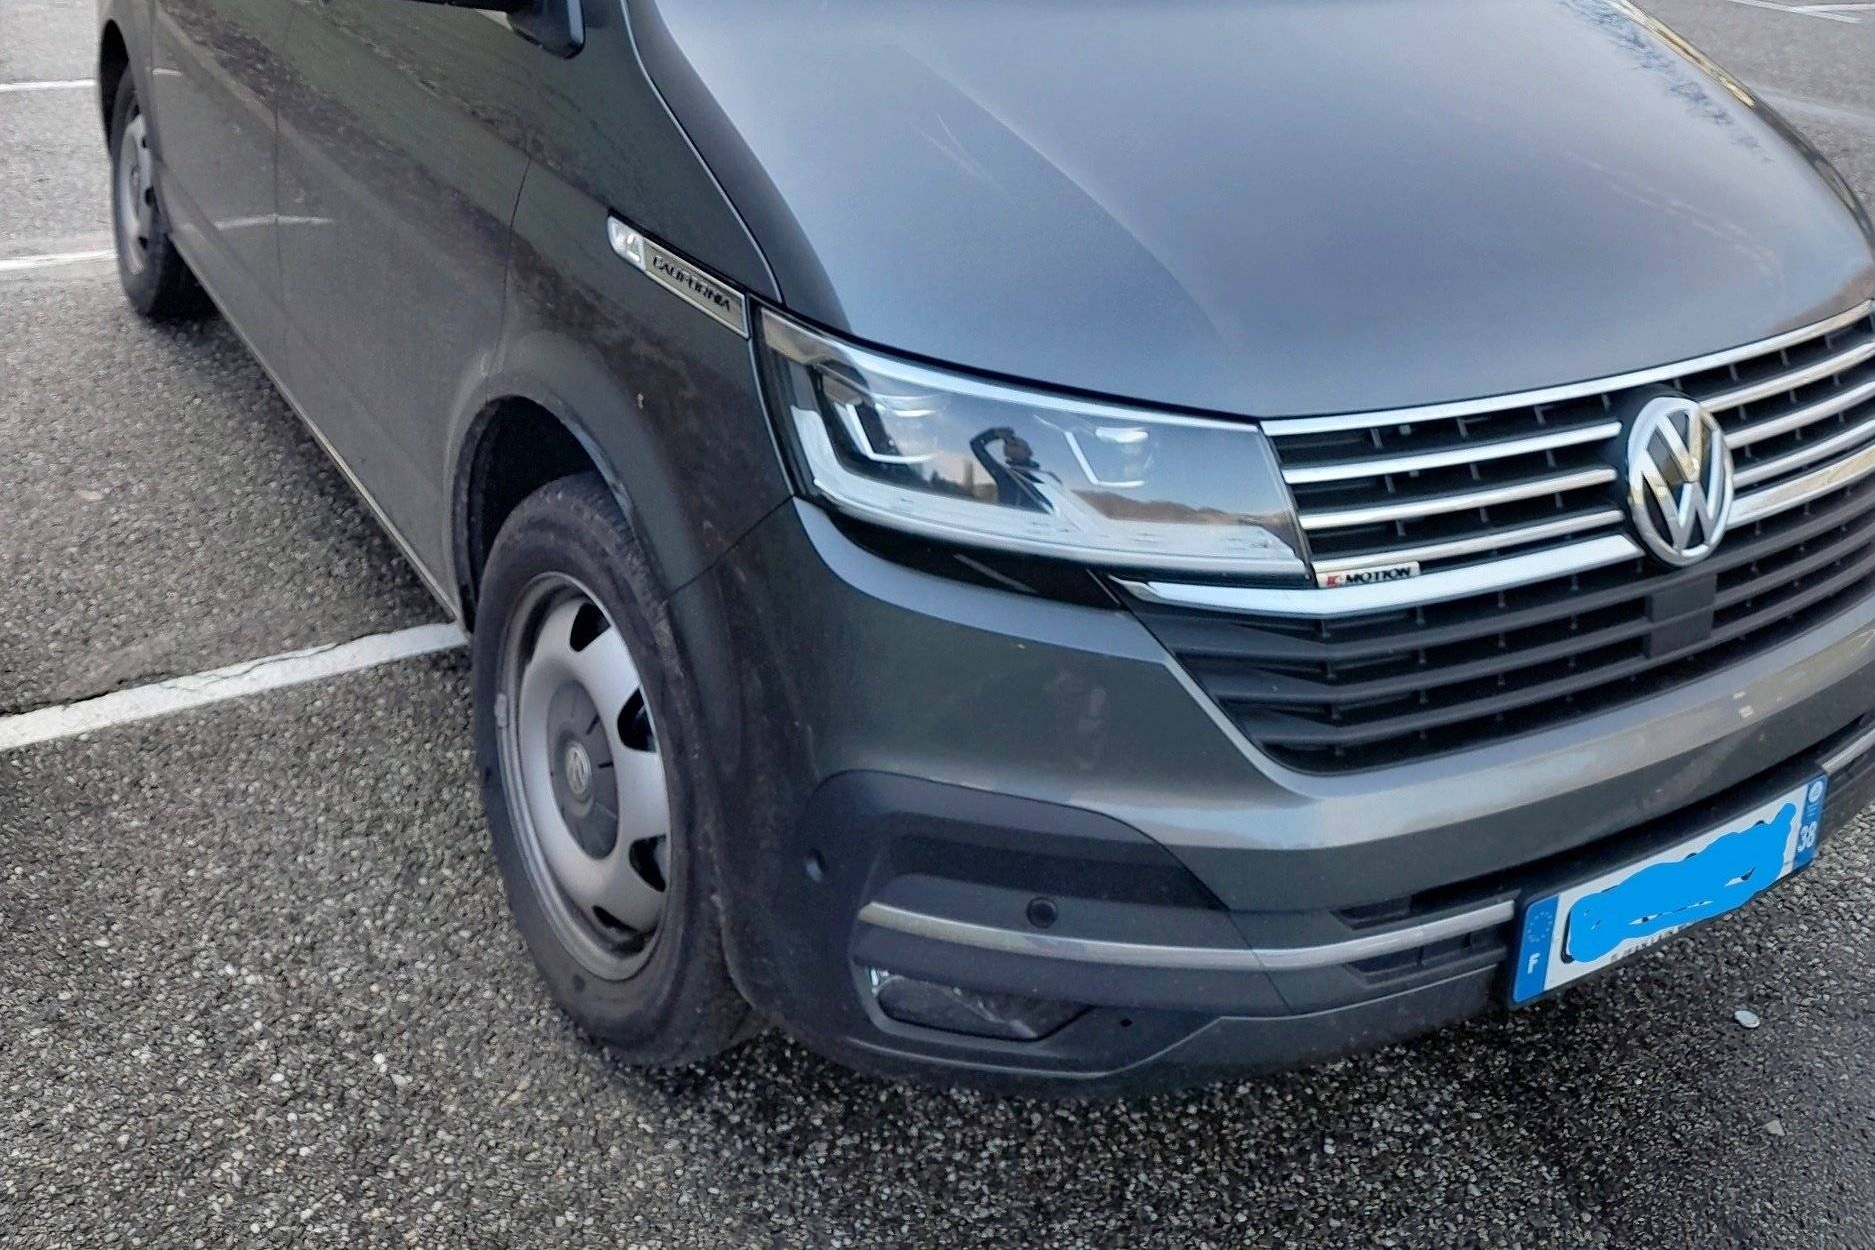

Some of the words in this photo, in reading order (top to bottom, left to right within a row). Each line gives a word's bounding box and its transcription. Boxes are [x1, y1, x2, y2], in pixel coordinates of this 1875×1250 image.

[1631, 400, 1731, 562] VW
[1797, 821, 1818, 853] 38
[1527, 952, 1541, 975] F
